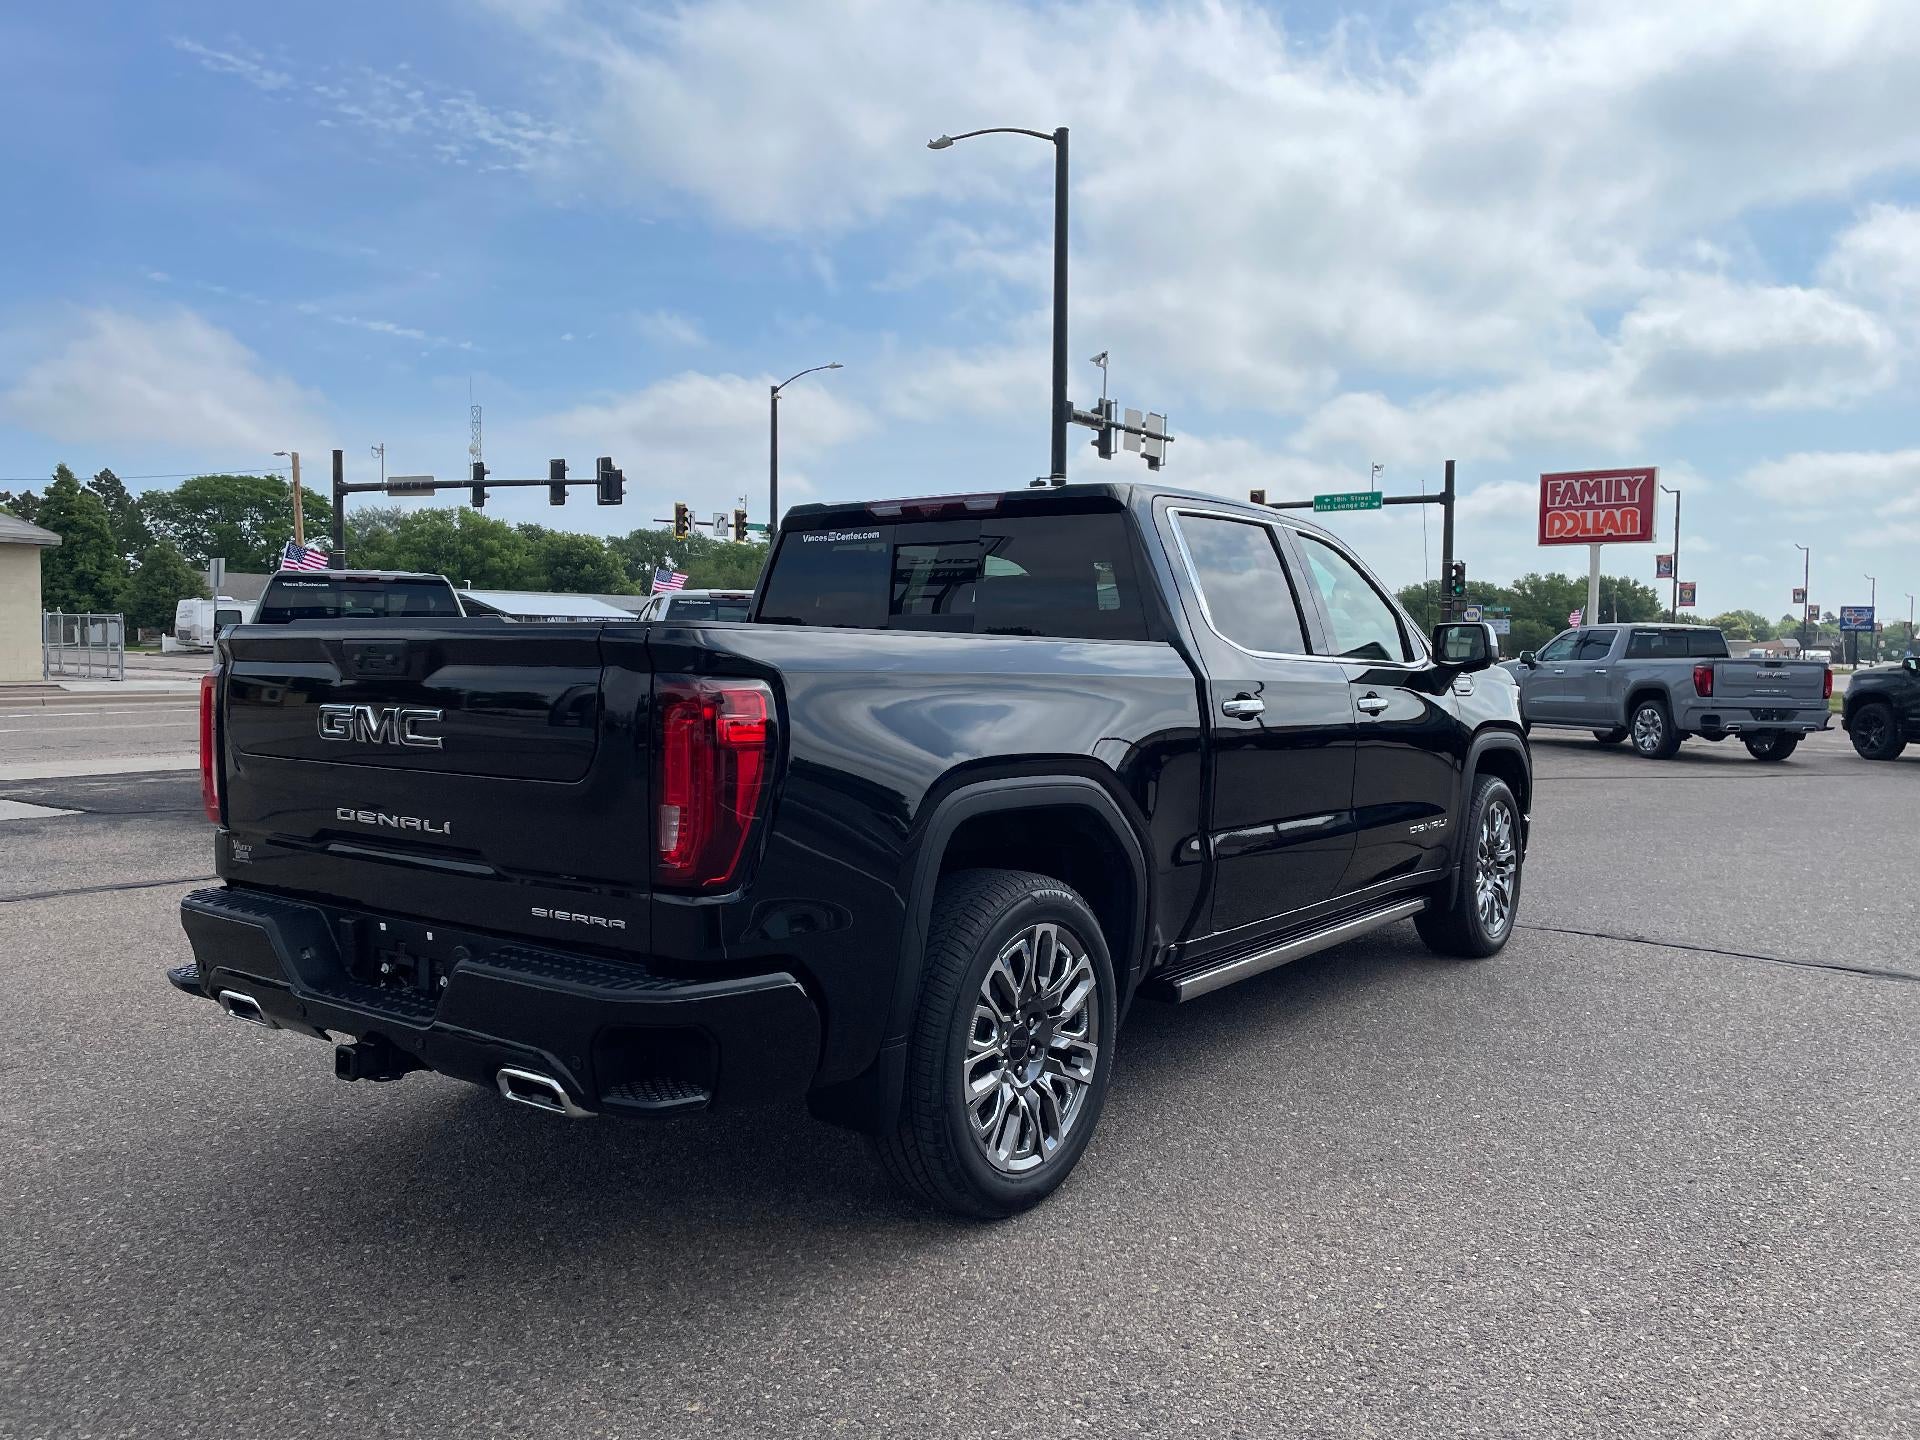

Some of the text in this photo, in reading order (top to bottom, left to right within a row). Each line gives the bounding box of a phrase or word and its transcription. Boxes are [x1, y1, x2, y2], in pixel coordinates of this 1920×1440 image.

[1546, 475, 1647, 507] FAMILY
[1545, 507, 1641, 538] DOLLAR
[317, 703, 443, 748] GMC
[336, 807, 451, 835] DENALI
[1409, 818, 1448, 835] DENALI
[531, 907, 626, 929] SIERRA
